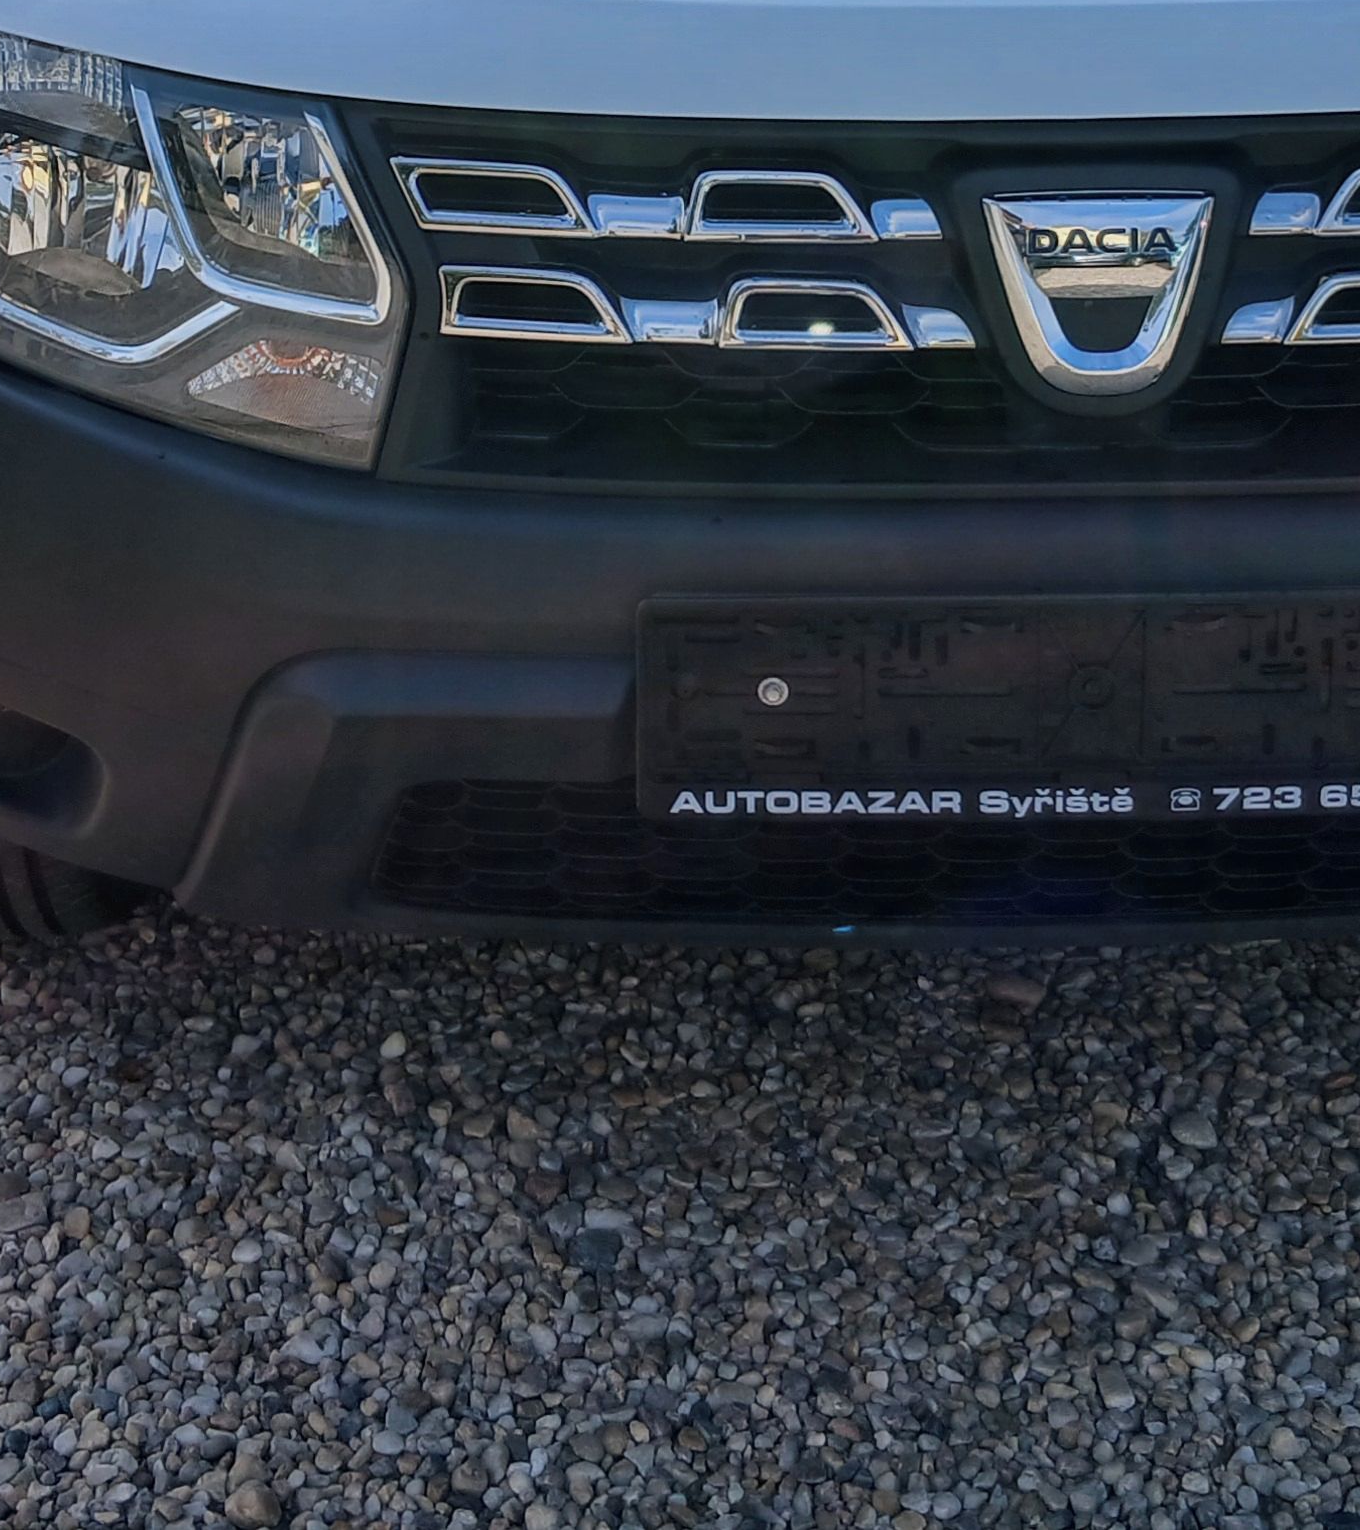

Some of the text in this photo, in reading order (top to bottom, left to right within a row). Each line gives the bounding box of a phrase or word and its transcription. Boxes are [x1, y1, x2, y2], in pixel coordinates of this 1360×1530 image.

[1027, 227, 1177, 254] DACIA
[669, 790, 962, 815] AUTOBAZAR
[978, 787, 1135, 818] Syřiště
[1212, 786, 1303, 810] 723
